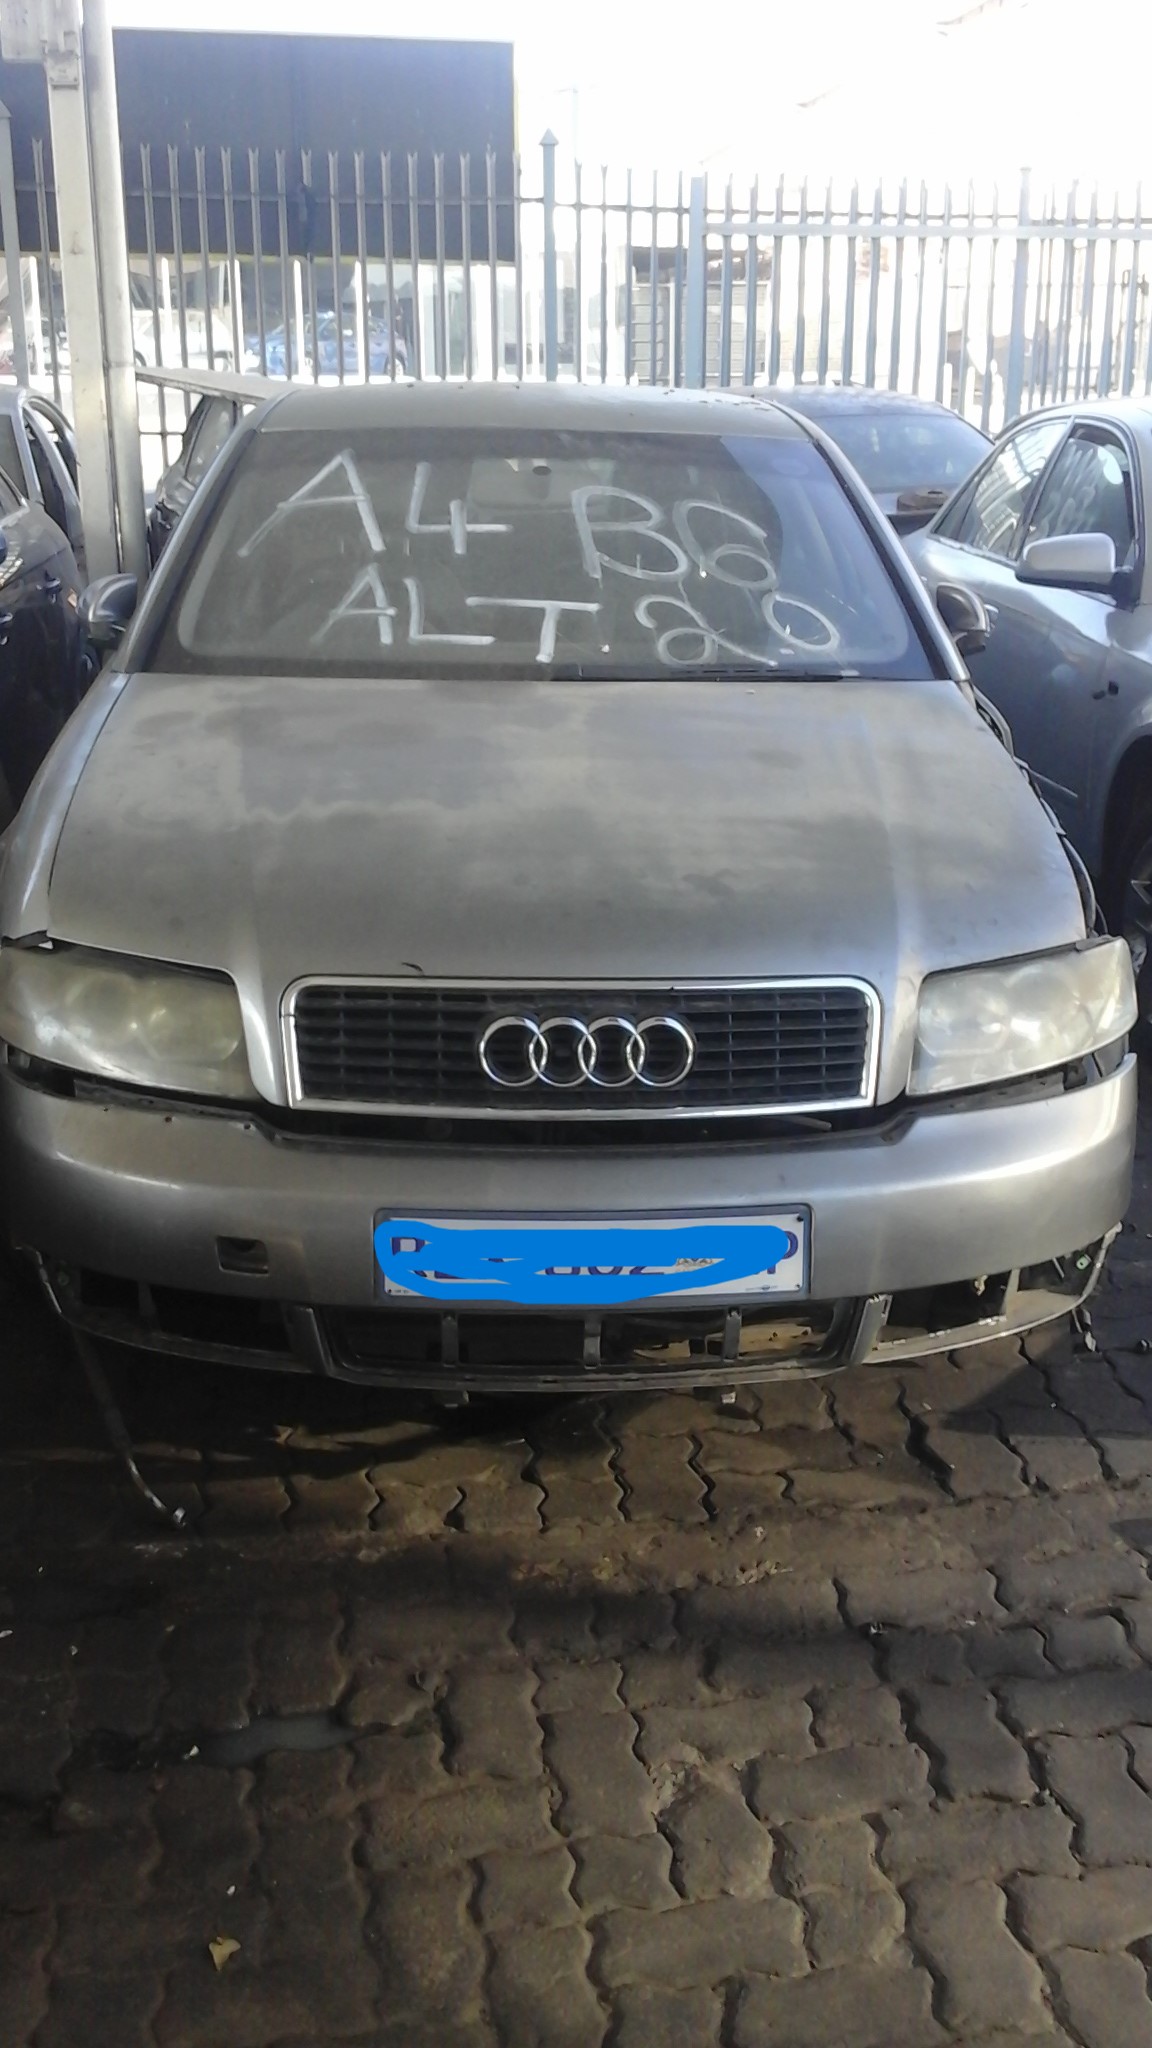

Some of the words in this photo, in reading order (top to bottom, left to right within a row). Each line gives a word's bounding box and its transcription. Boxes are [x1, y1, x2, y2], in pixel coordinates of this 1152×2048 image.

[237, 448, 513, 555] A4
[571, 485, 779, 590] B6
[309, 562, 600, 663] ALT
